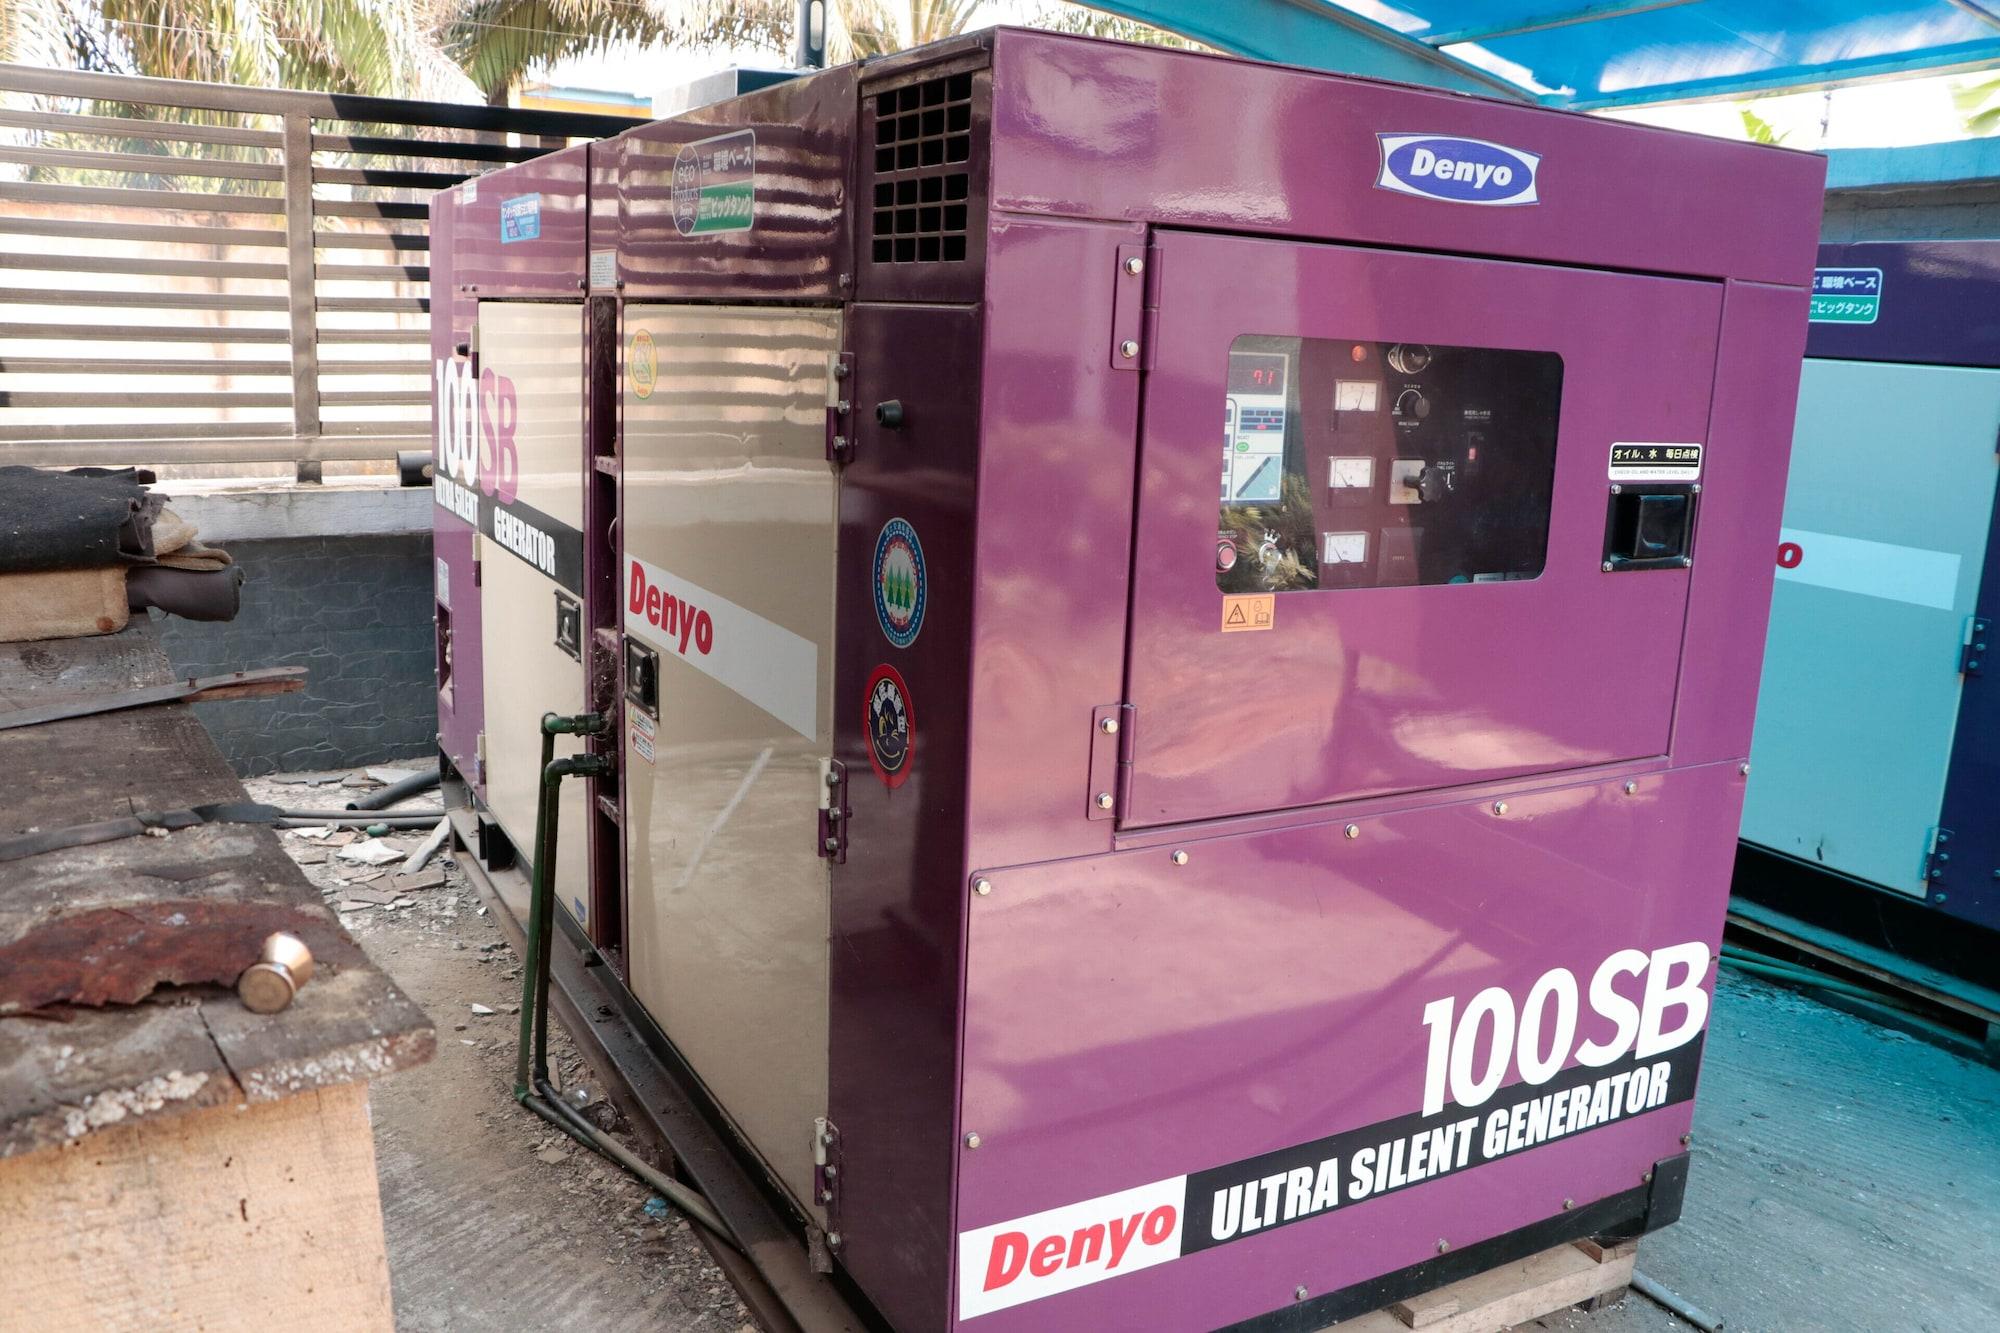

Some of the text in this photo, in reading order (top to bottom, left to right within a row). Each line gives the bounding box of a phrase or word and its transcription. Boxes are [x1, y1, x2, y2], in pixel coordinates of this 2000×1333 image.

[678, 164, 695, 183] eco
[713, 146, 752, 172] 環境ベース
[1410, 148, 1512, 189] Denyo
[711, 194, 751, 218] ビッグタンク
[1821, 276, 1877, 289] 環境ベース
[1817, 301, 1874, 315] ビッグタンク
[436, 357, 518, 505] 100SB
[494, 506, 555, 576] GENERATOR
[629, 560, 713, 655] Denyo
[1421, 941, 1710, 1117] 100SB
[983, 1061, 1671, 1292] Denyo ULTRA SILENT GENERATOR
